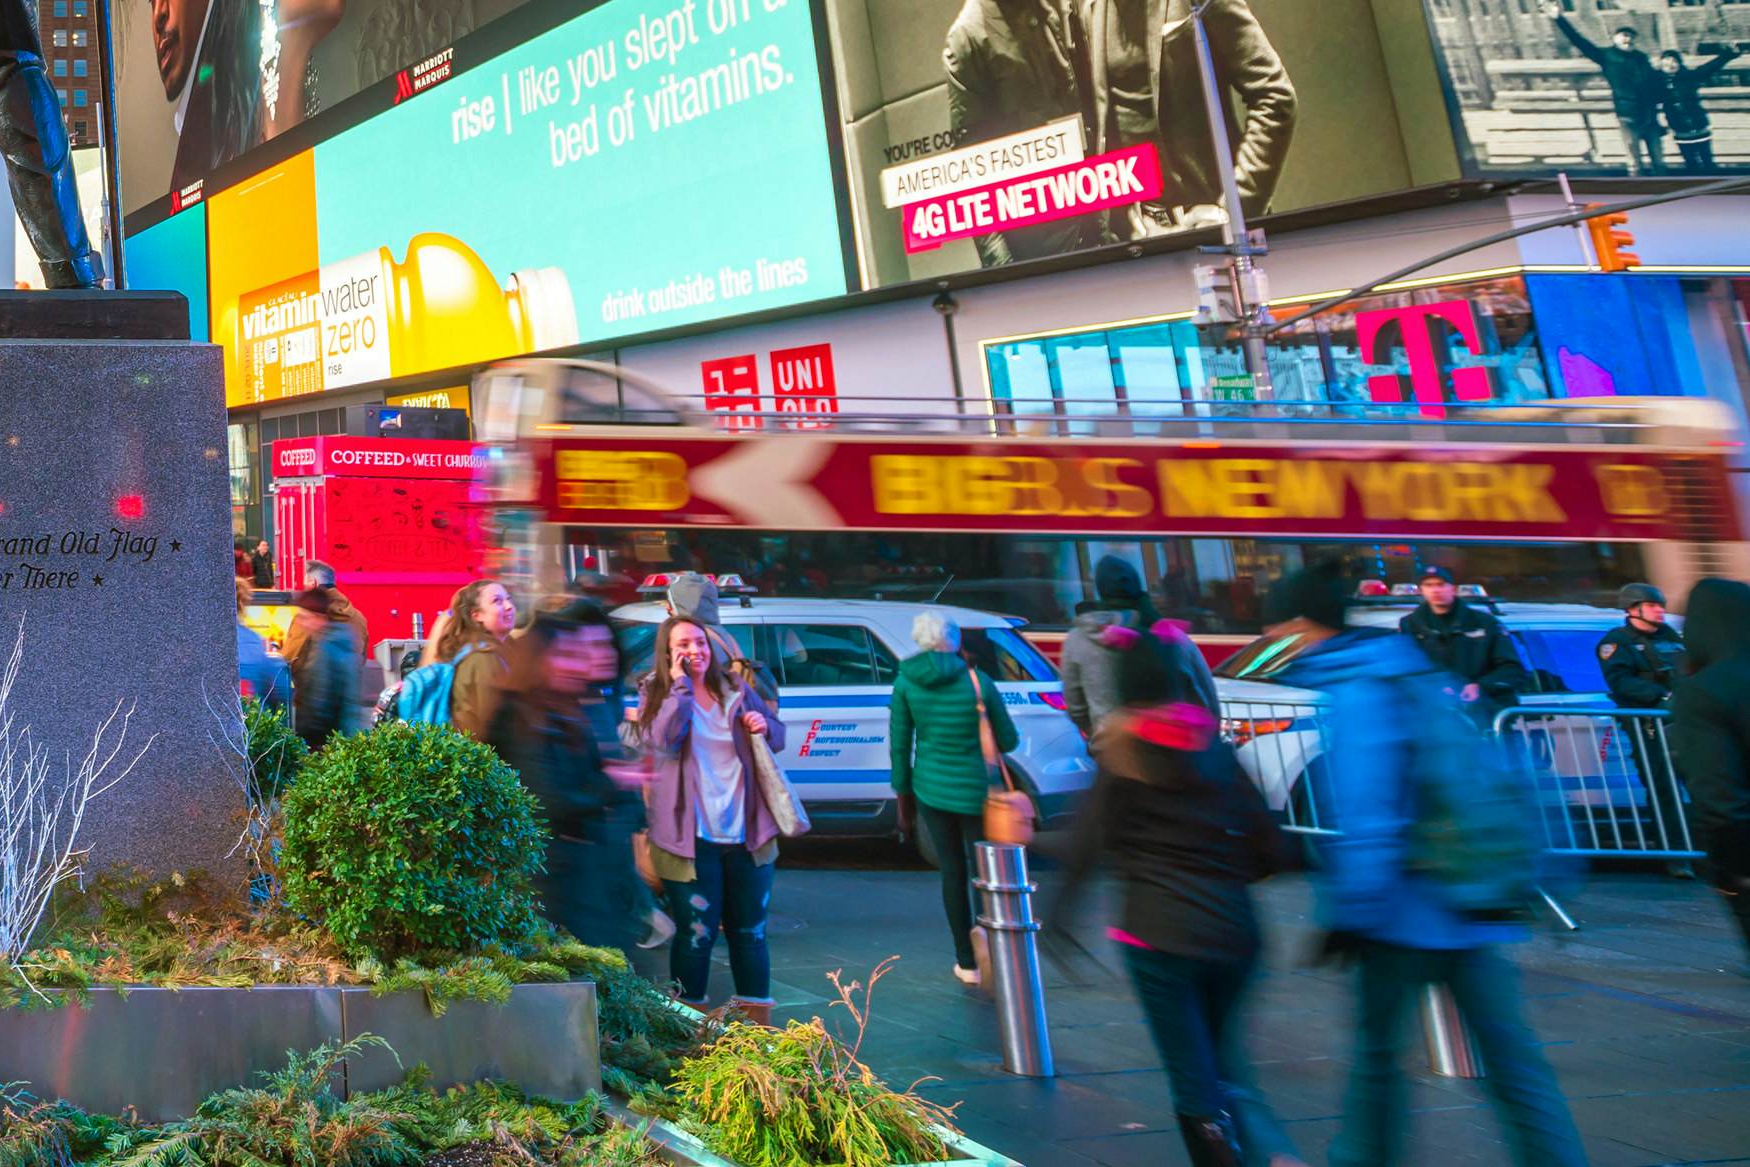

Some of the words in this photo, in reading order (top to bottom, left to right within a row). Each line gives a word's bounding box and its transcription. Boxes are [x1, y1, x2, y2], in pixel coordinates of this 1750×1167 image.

[413, 47, 454, 78] MARRIOTT
[414, 64, 451, 91] MARQUIS
[450, 88, 496, 145] rise
[519, 63, 561, 117] like
[567, 41, 617, 115] you
[551, 104, 600, 169] bed
[607, 91, 637, 147] of
[643, 42, 795, 134] vitamins.
[884, 136, 930, 164] YOU'RE
[897, 152, 987, 197] AMERICA'S
[990, 133, 1069, 176] FASTEST
[911, 203, 948, 242] 4G
[949, 190, 994, 233] LTE
[996, 155, 1145, 224] NETWORK
[600, 286, 647, 323] drink
[648, 270, 716, 314] outside
[718, 264, 752, 300] the
[757, 256, 809, 292] lines
[327, 315, 376, 357] zero
[327, 362, 343, 377] rise
[778, 356, 825, 392] UNI
[1355, 299, 1494, 421] T
[280, 448, 316, 466] COFFEED
[331, 449, 405, 466] COFFEED
[412, 452, 443, 468] SWEET
[59, 531, 100, 556] Old
[107, 527, 158, 562] Flag
[19, 561, 80, 590] There
[810, 719, 859, 732] COURTESY
[798, 744, 842, 758] RESPECT
